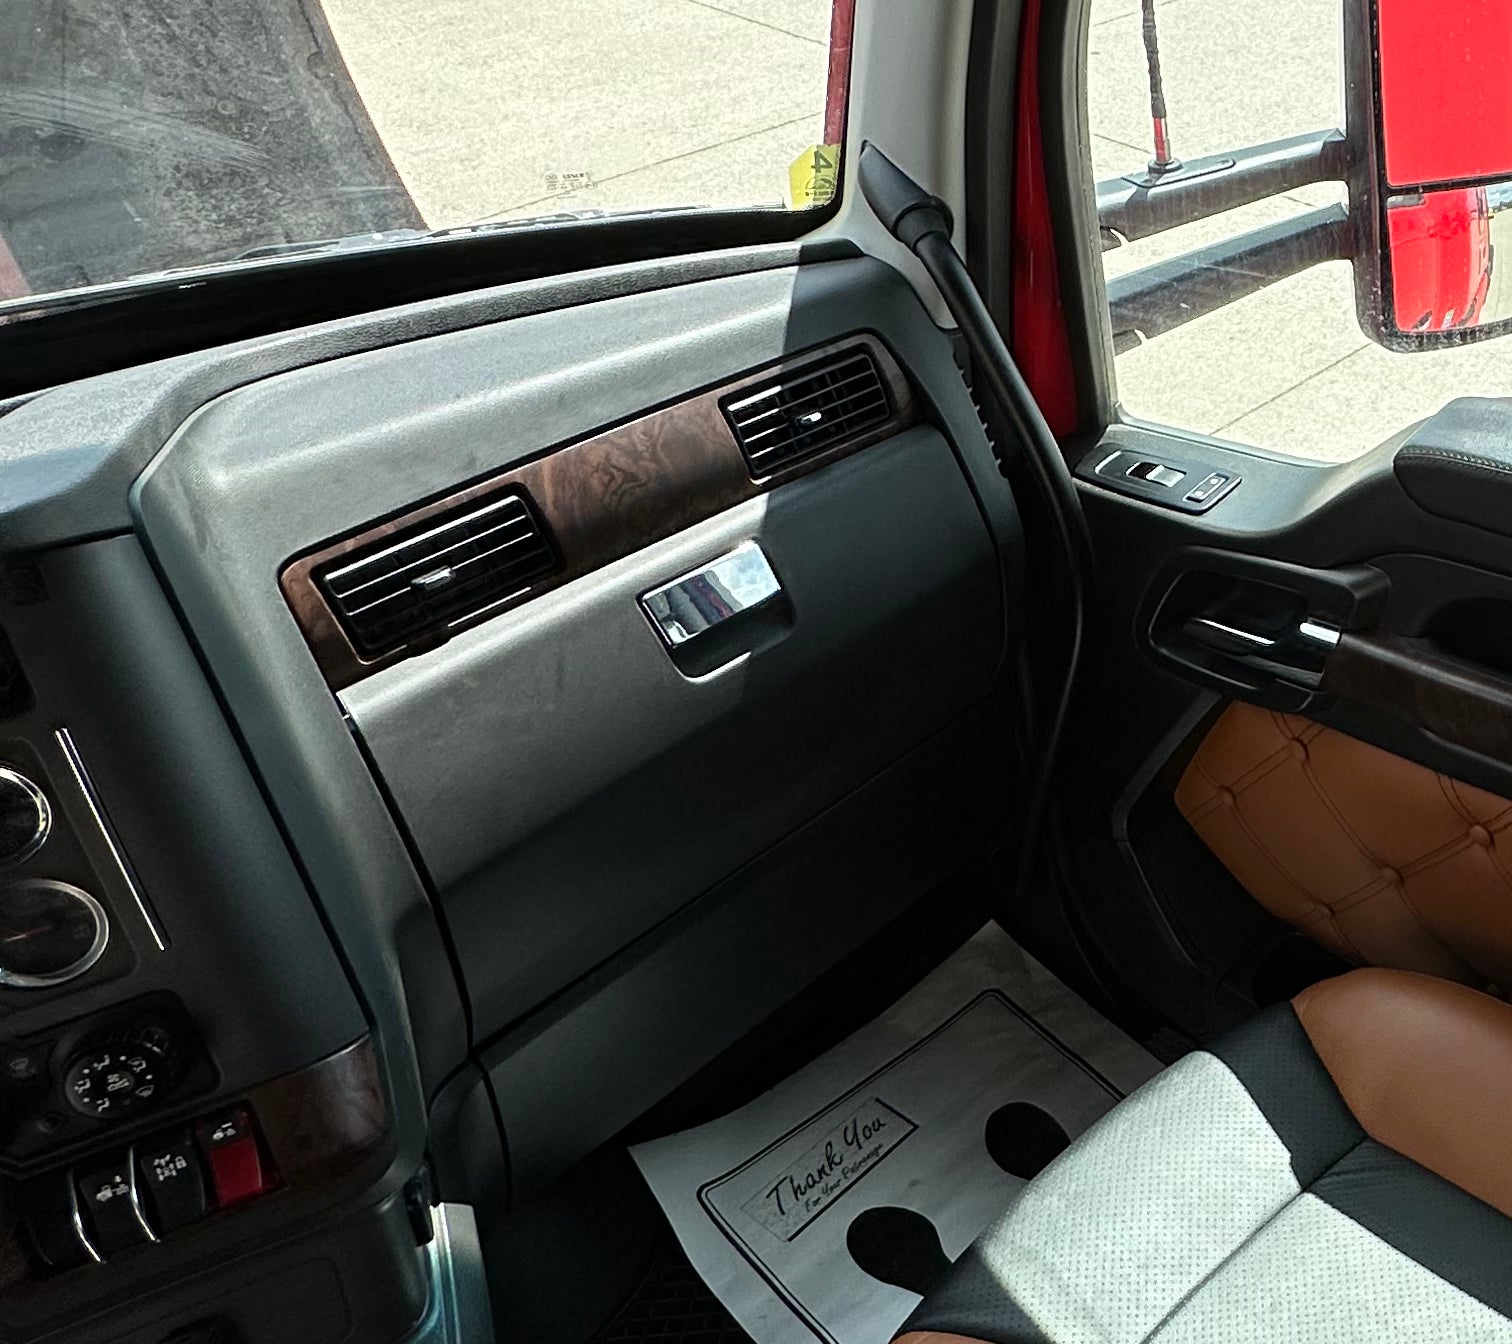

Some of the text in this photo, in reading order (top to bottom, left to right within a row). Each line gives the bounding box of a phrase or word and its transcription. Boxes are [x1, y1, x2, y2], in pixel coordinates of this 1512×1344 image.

[766, 1118, 887, 1216] Thank You
[804, 1197, 822, 1213] For
[822, 1179, 842, 1198] Your
